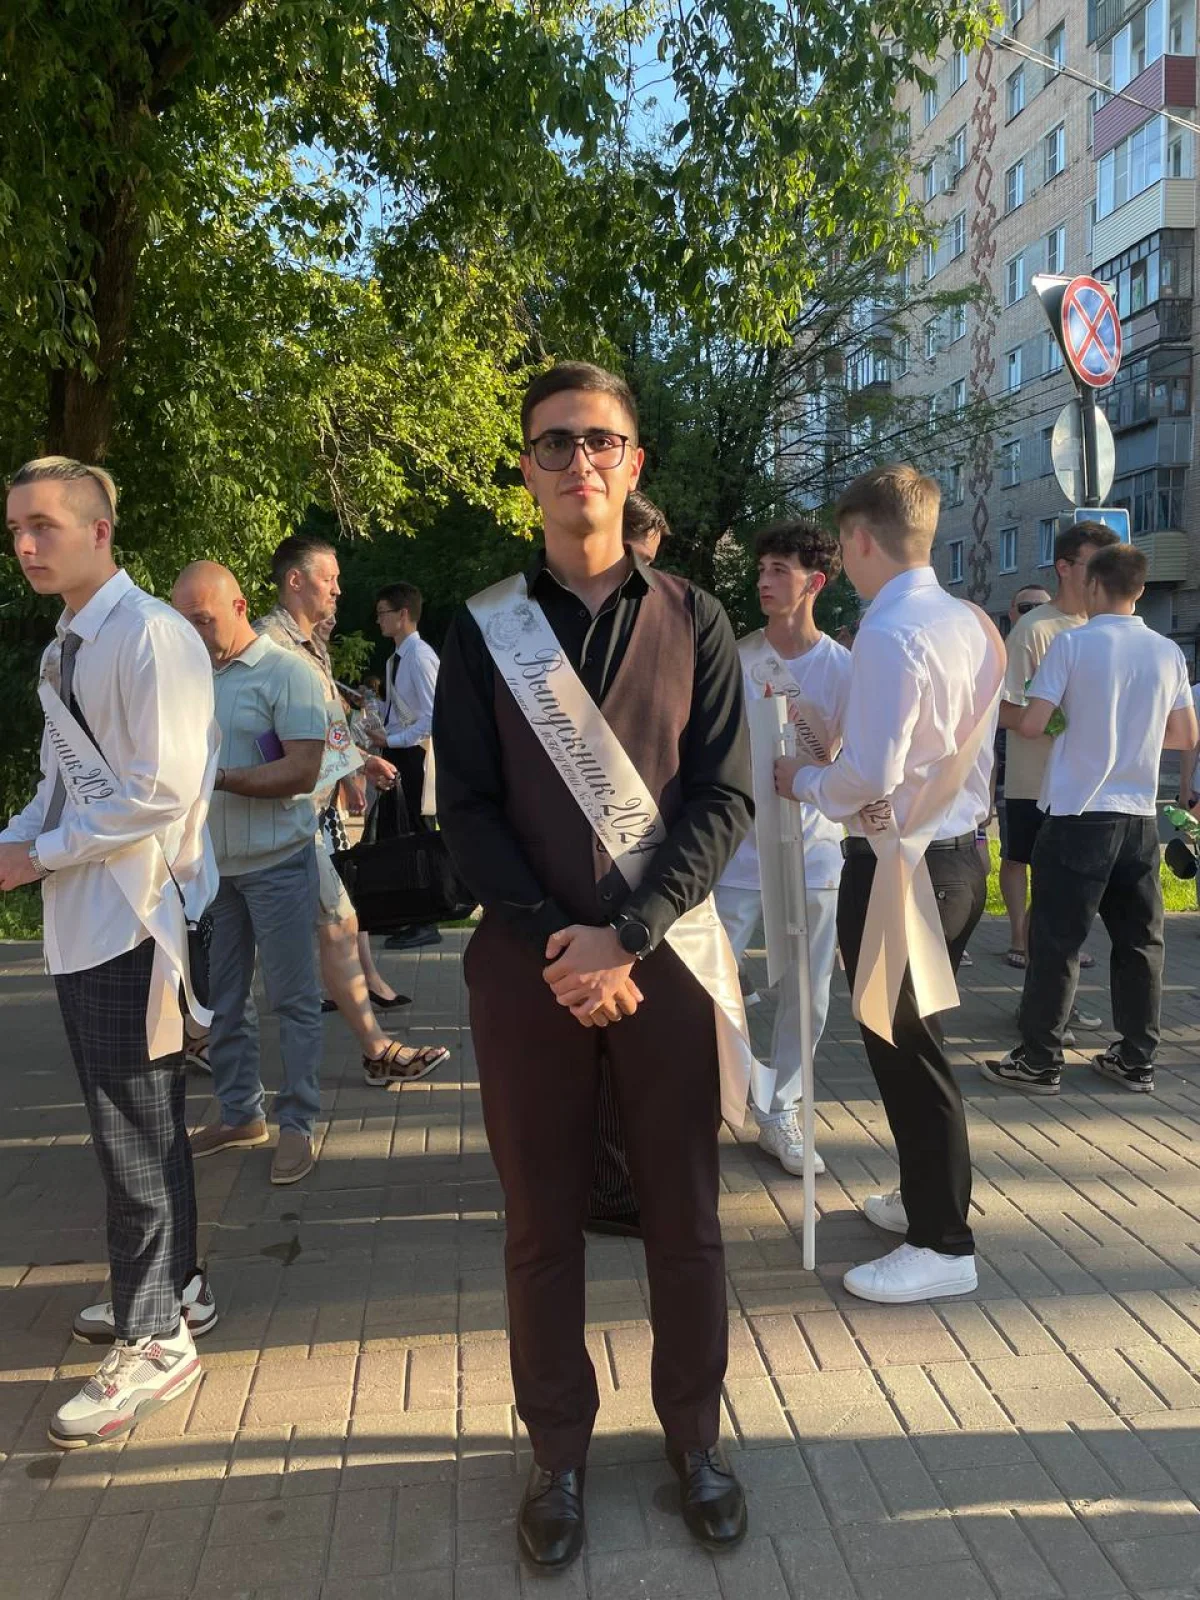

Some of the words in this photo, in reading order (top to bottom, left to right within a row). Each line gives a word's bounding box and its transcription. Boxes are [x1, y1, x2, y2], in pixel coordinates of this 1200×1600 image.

[72, 768, 114, 805] 202
[514, 648, 616, 800] Выпускник
[600, 797, 659, 855] 2024
